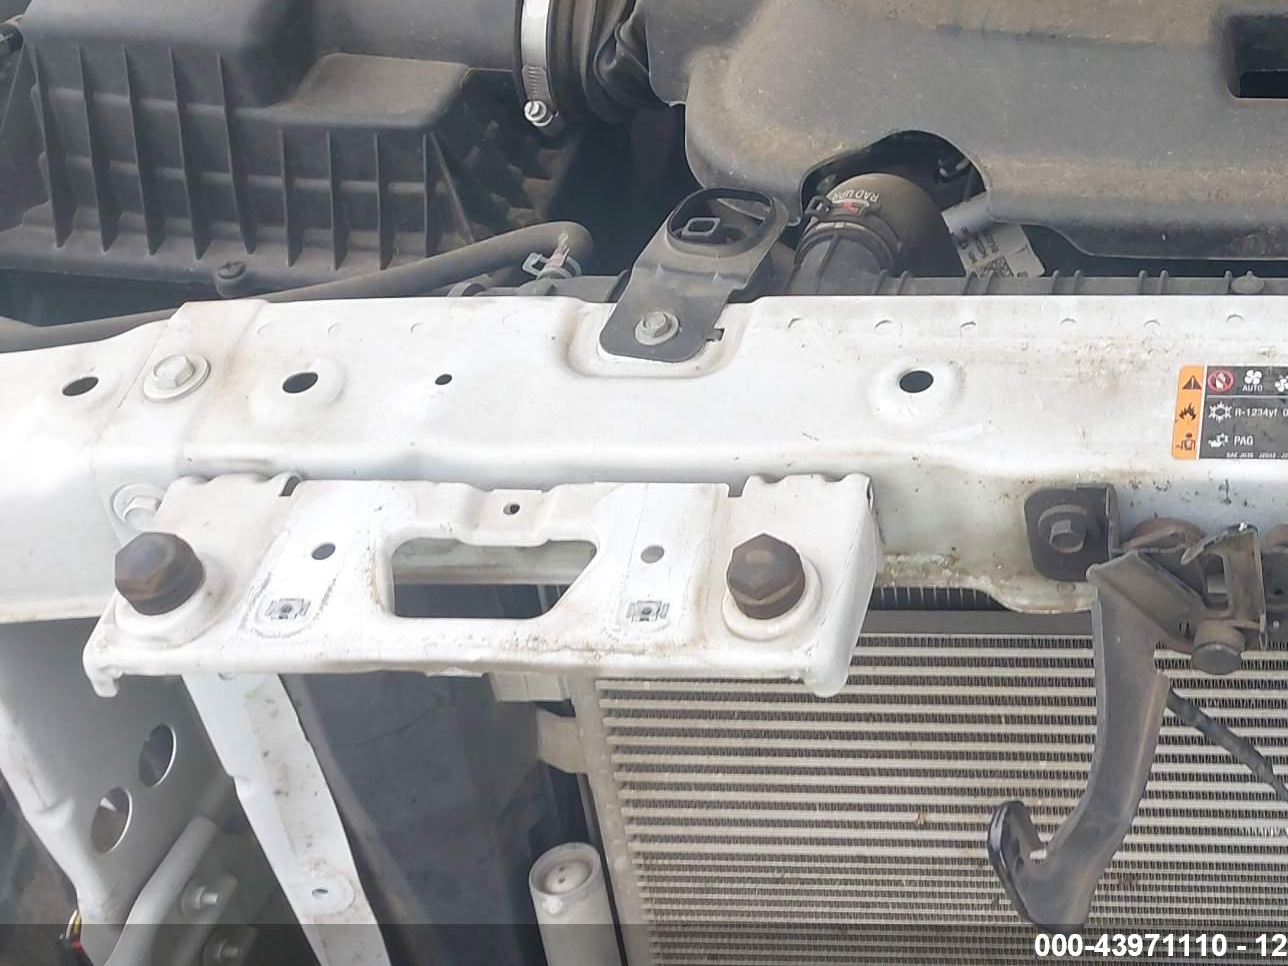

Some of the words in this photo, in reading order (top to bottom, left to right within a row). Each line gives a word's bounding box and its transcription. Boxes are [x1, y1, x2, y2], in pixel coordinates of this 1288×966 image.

[1242, 384, 1263, 393] AUTO
[1234, 407, 1278, 419] R-1234yf
[1233, 435, 1254, 446] PAG
